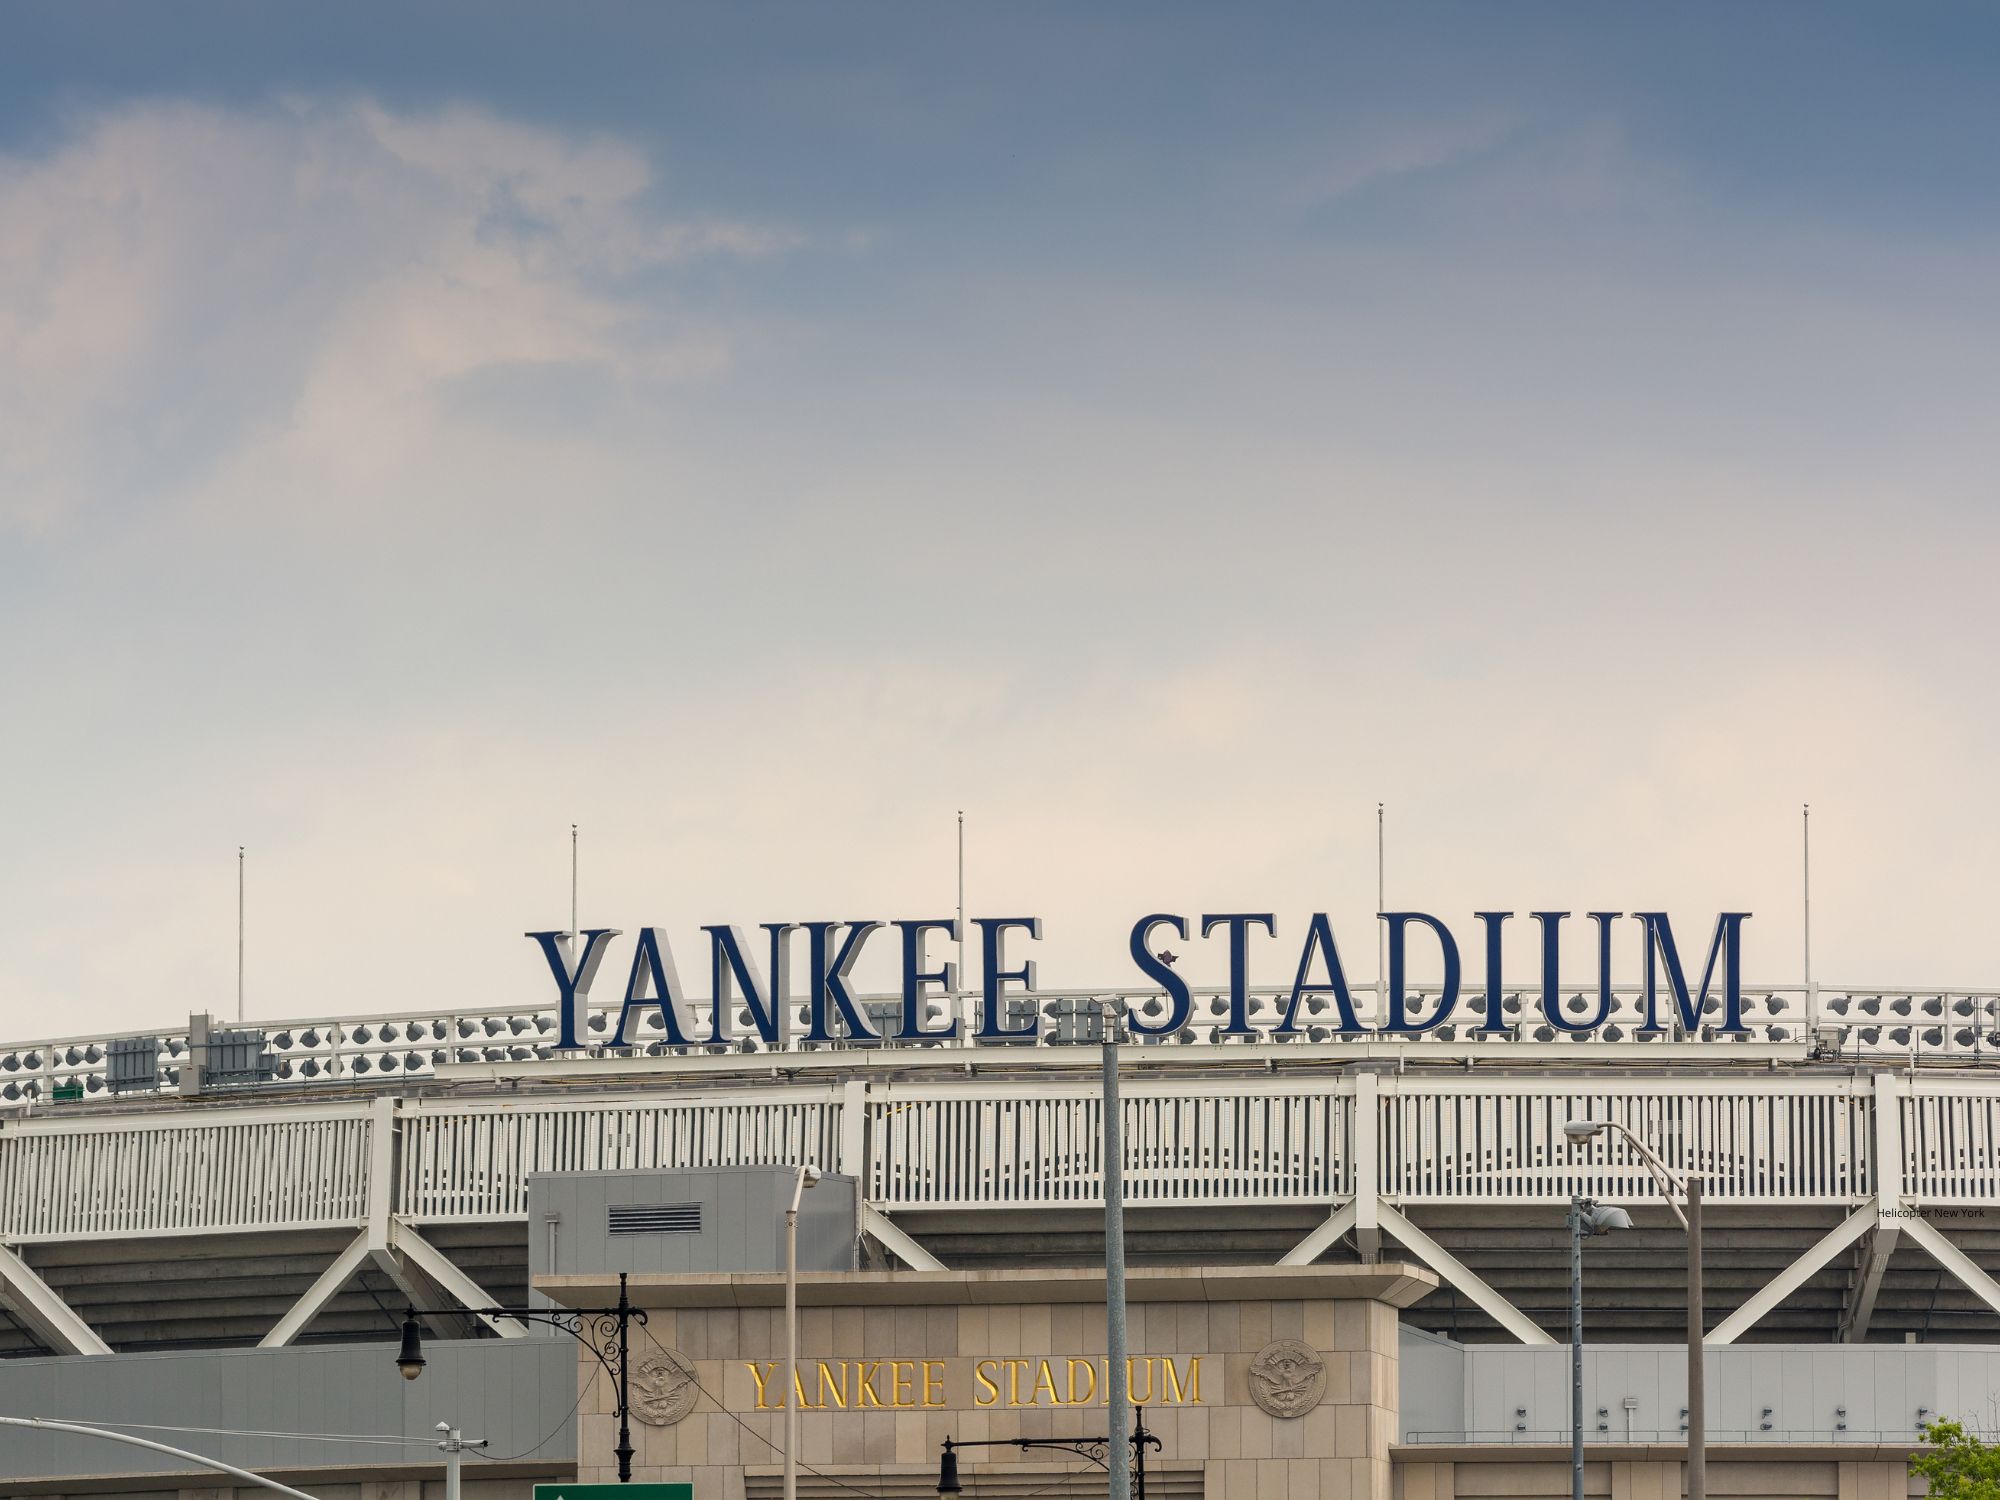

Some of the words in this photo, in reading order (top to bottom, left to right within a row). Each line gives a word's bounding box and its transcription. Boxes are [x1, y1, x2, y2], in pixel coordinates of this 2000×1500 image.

[525, 917, 1043, 1050] YANKEE
[1128, 911, 1752, 1036] STADIUM
[744, 1360, 946, 1409] YANKEE
